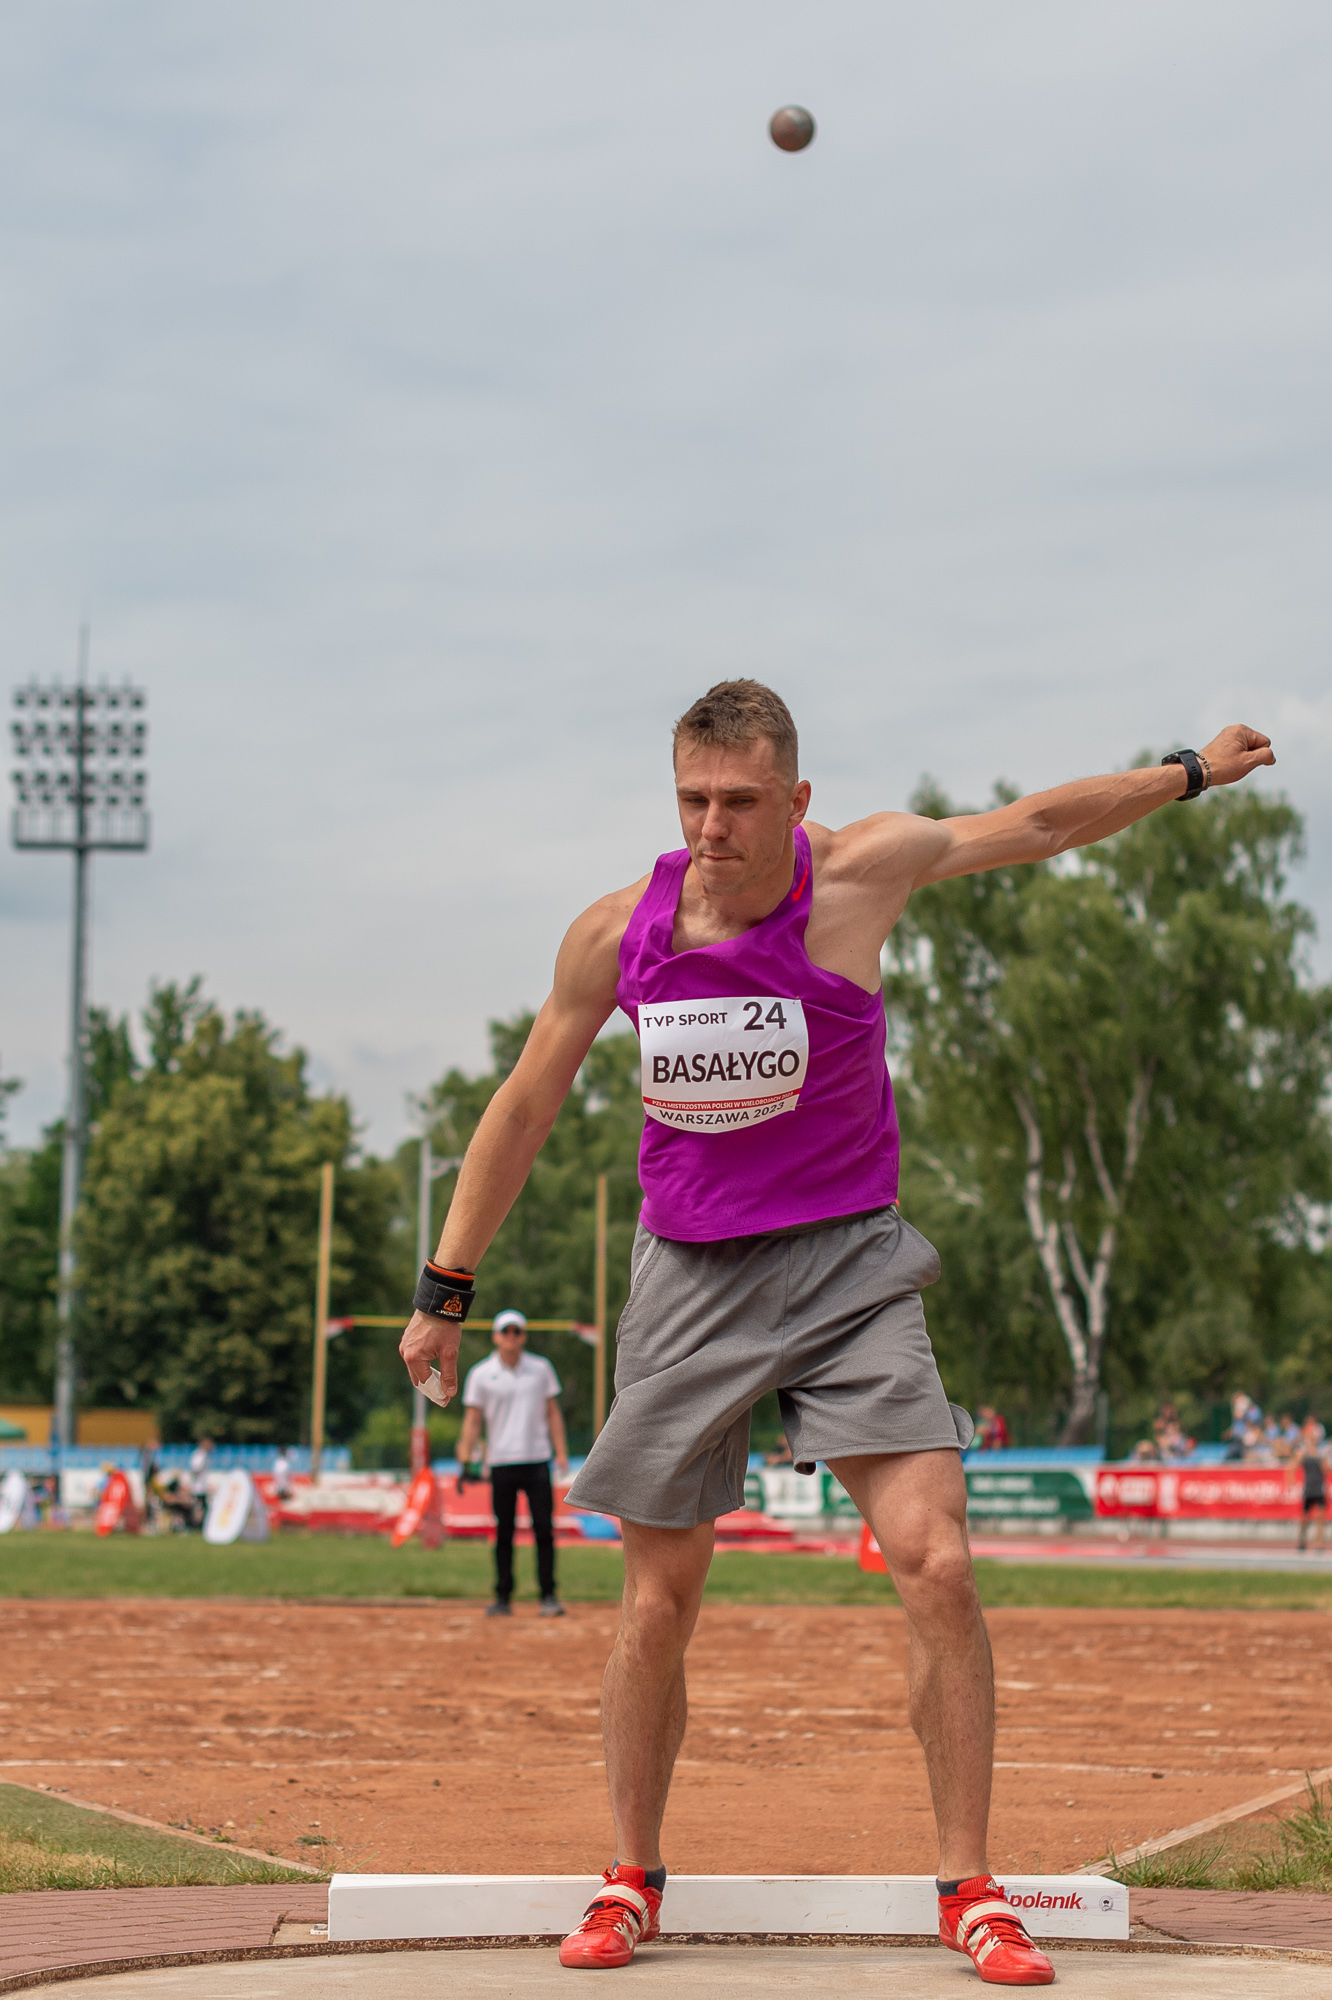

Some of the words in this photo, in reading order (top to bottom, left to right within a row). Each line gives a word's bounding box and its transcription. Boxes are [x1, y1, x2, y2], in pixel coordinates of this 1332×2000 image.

[643, 1015, 675, 1028] TVP
[678, 1012, 728, 1026] SPORT
[742, 1001, 787, 1031] 24
[652, 1049, 800, 1084] BASAŁYGO
[659, 1109, 750, 1125] WARSZAWA
[752, 1101, 785, 1119] 2023
[711, 1101, 733, 1109] POLSKI
